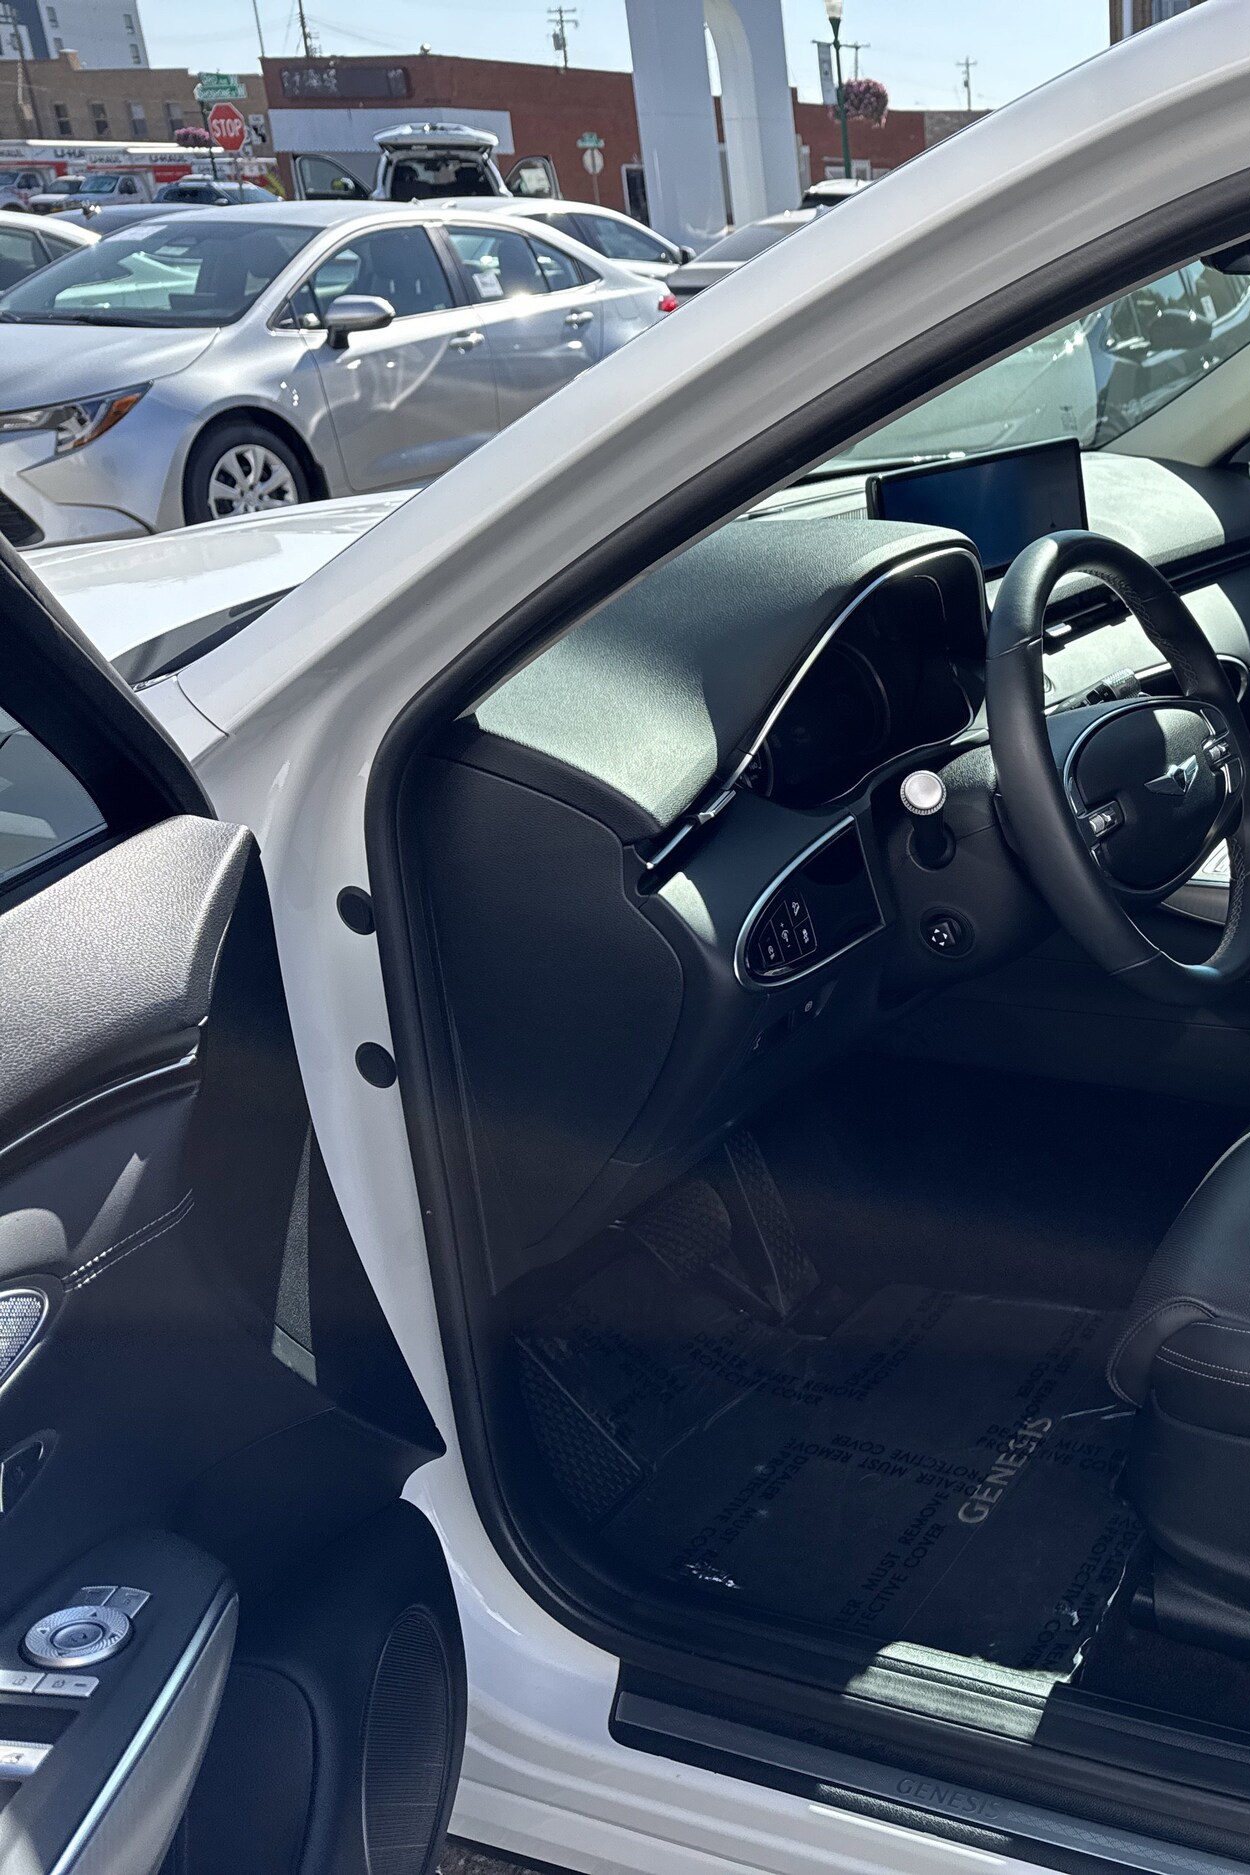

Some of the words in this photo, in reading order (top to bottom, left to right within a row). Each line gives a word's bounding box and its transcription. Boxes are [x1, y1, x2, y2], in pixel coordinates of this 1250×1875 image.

[211, 118, 242, 137] STOP
[694, 1331, 749, 1371] DEALER
[753, 1368, 800, 1386] MUST
[802, 1379, 869, 1402] REMOVE
[771, 1386, 824, 1407] COVER
[783, 1437, 853, 1464] REMOVE
[831, 1433, 885, 1456] COVER
[1053, 1438, 1105, 1457] MUST
[758, 1455, 810, 1501] DEALER
[857, 1456, 908, 1478] MUST
[889, 1448, 989, 1485] PROTECTIVE
[914, 1471, 977, 1498] DEALER
[957, 1416, 1053, 1524] GENESIS
[713, 1449, 792, 1524] PROTECTIVE
[719, 1506, 758, 1545] MUST
[861, 1551, 901, 1592] MUST
[898, 1491, 949, 1546] REMOVE
[903, 1523, 948, 1569] COVER
[896, 1778, 1004, 1820] GENESIS
